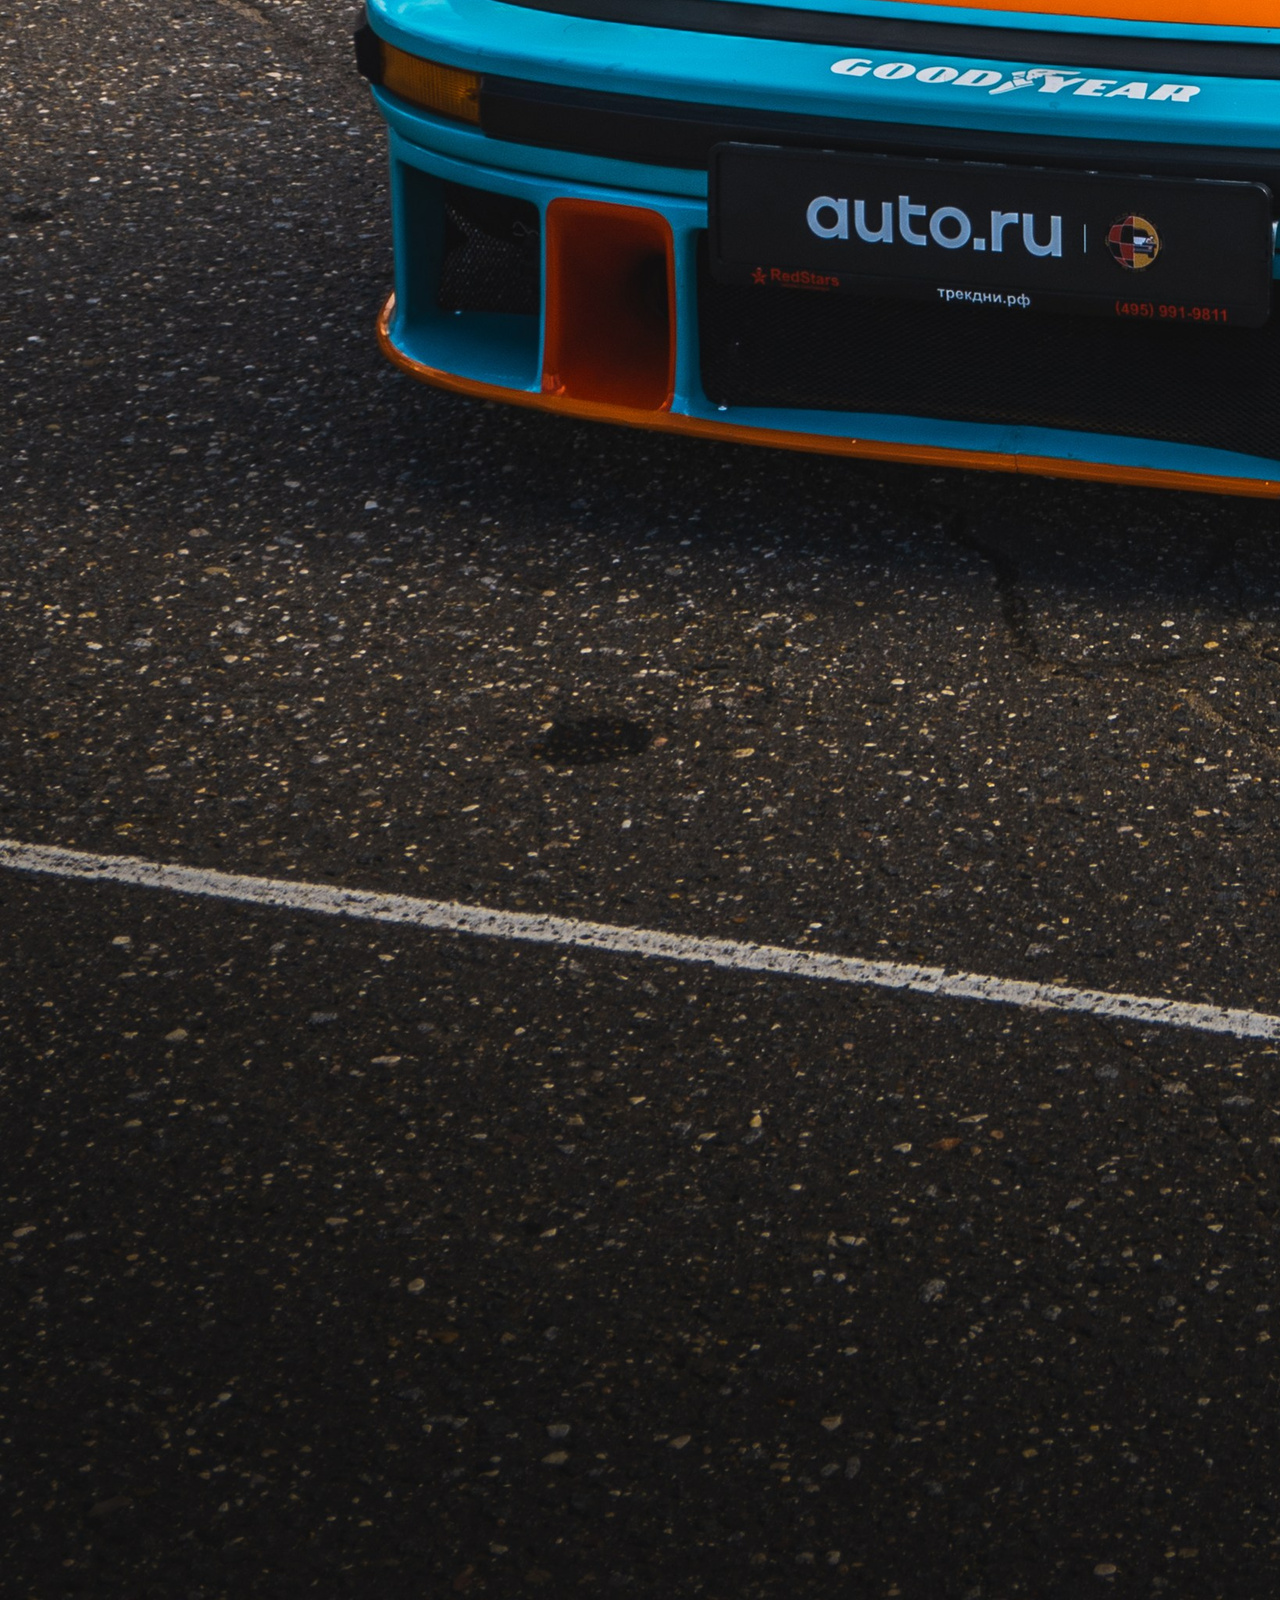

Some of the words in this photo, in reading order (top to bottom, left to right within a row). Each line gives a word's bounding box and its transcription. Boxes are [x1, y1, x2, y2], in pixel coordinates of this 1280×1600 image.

[806, 195, 1063, 258] auto.ru
[770, 267, 841, 287] RedStars
[937, 287, 1031, 308] трекдни.рф
[1115, 301, 1155, 319] (495)
[1158, 303, 1228, 322] 991-9811
